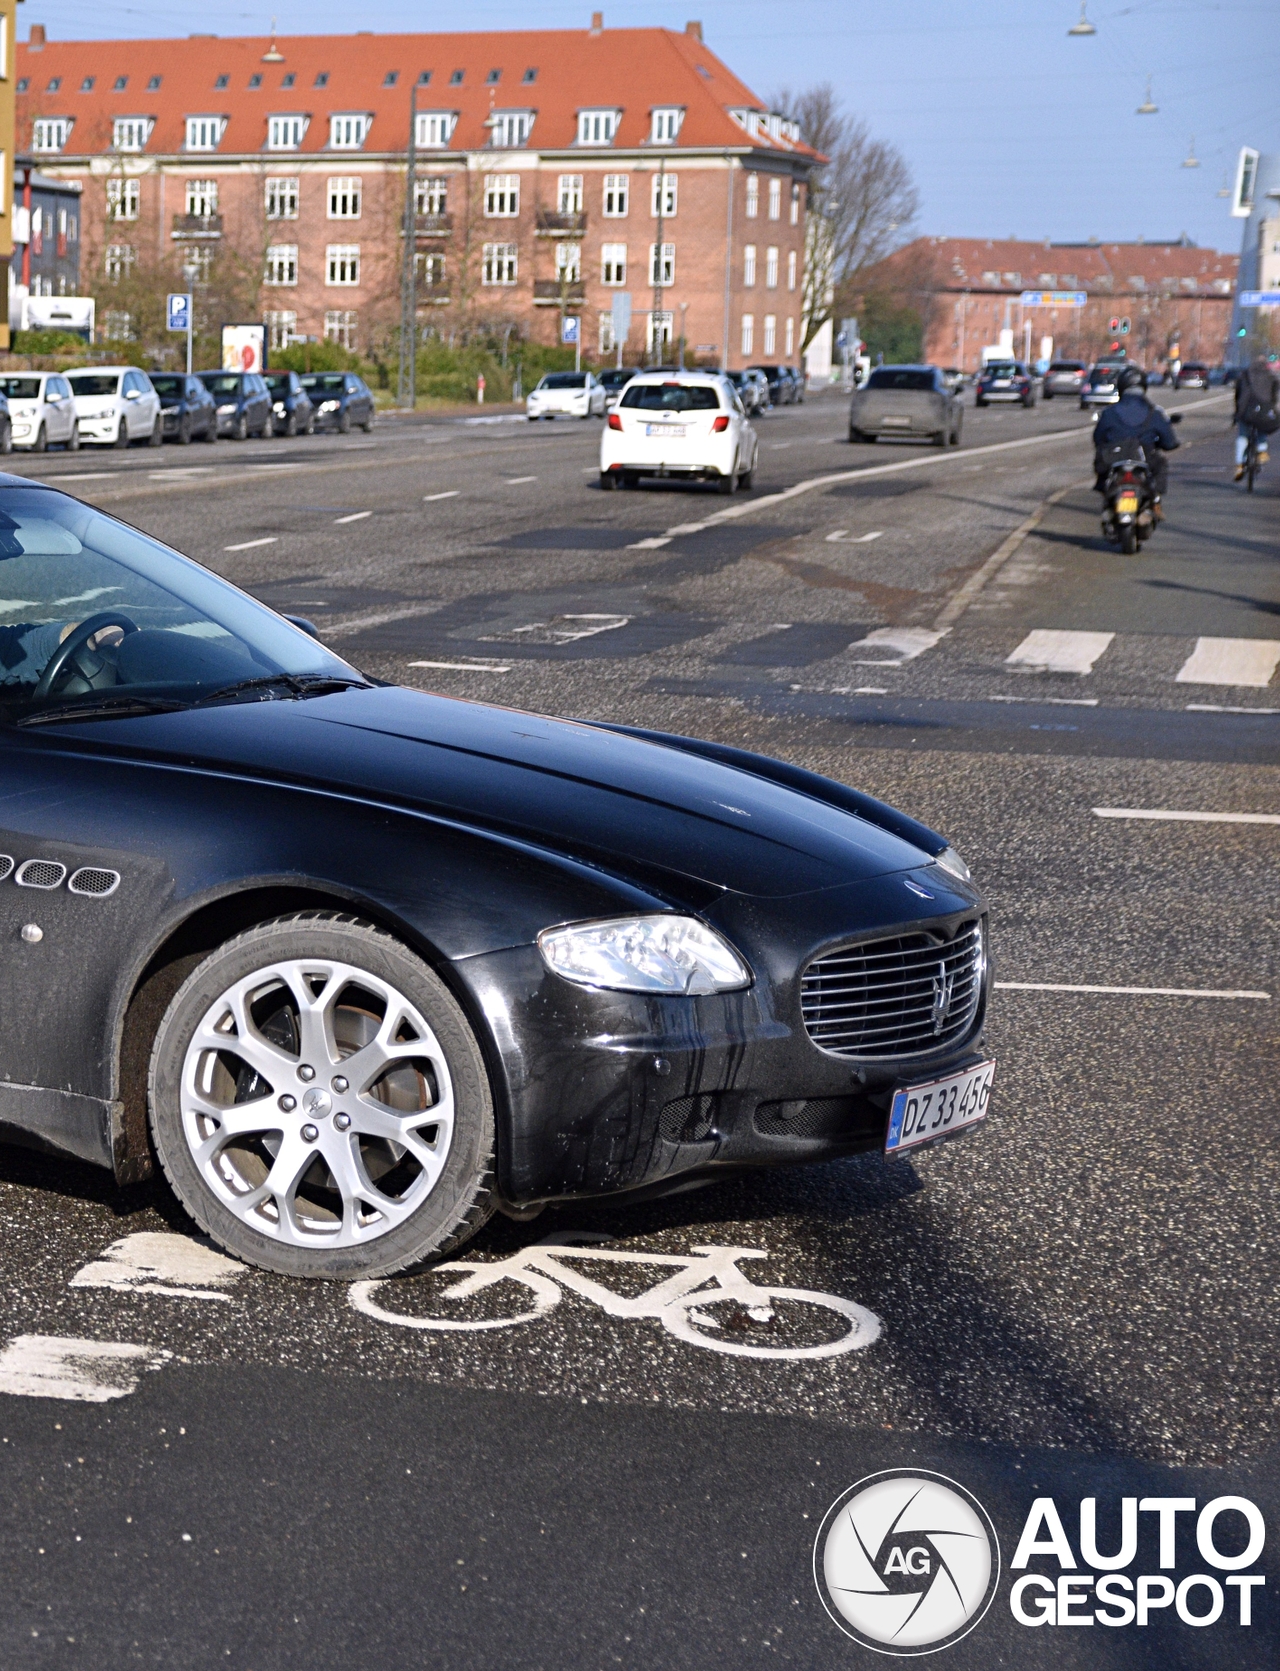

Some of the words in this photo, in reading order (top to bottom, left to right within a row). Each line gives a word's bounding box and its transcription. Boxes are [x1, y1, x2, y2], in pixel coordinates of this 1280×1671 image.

[172, 296, 186, 316] P
[902, 1093, 933, 1138] DZ
[931, 1085, 958, 1129] 33
[958, 1069, 991, 1118] 456
[889, 1125, 899, 1139] DK
